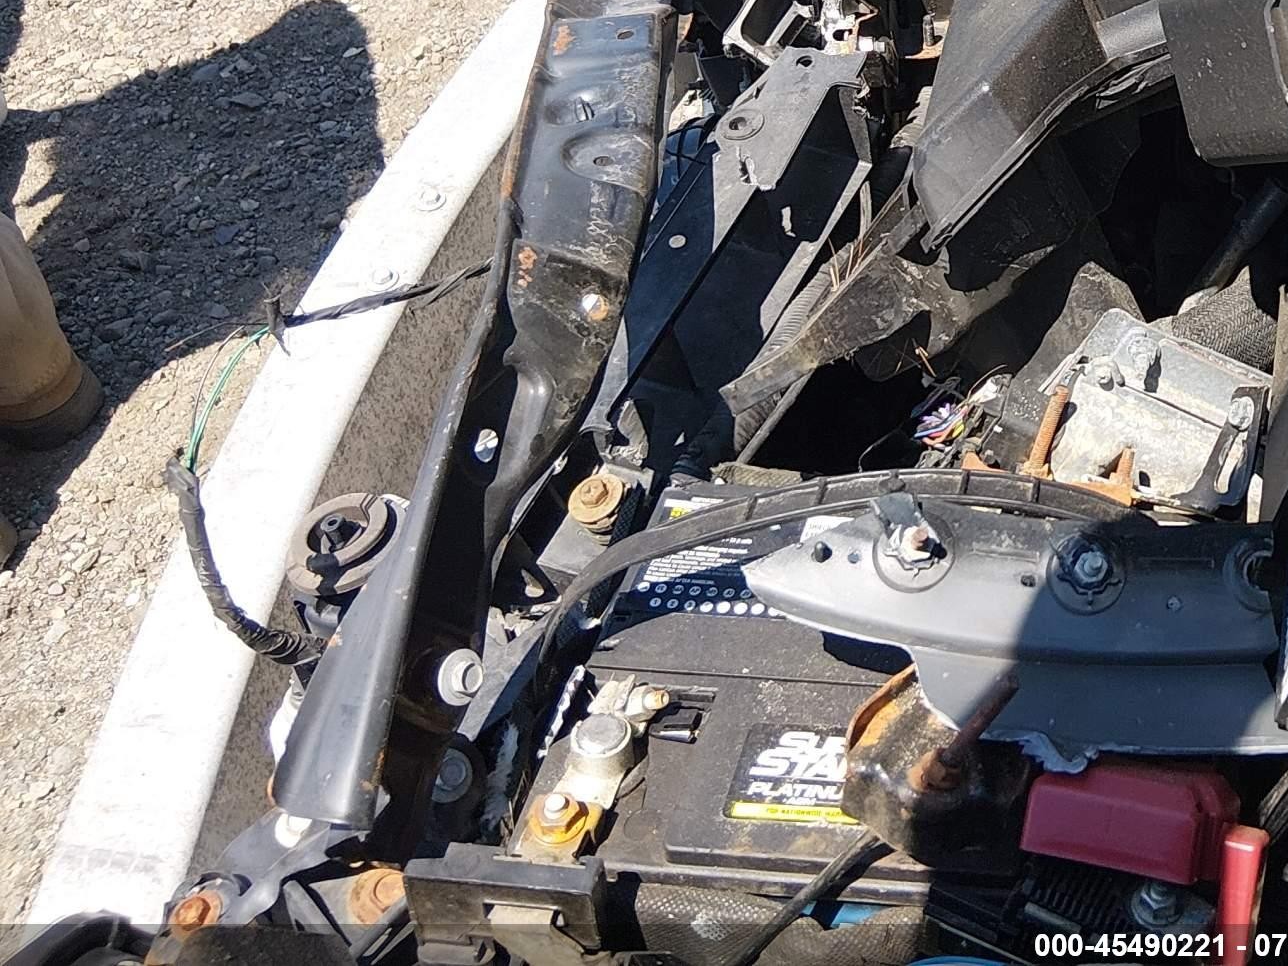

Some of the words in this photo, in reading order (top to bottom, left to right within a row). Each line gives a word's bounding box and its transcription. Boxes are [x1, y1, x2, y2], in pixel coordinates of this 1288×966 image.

[775, 731, 846, 756] SUP
[749, 748, 847, 780] STA
[747, 782, 843, 801] PLATINU
